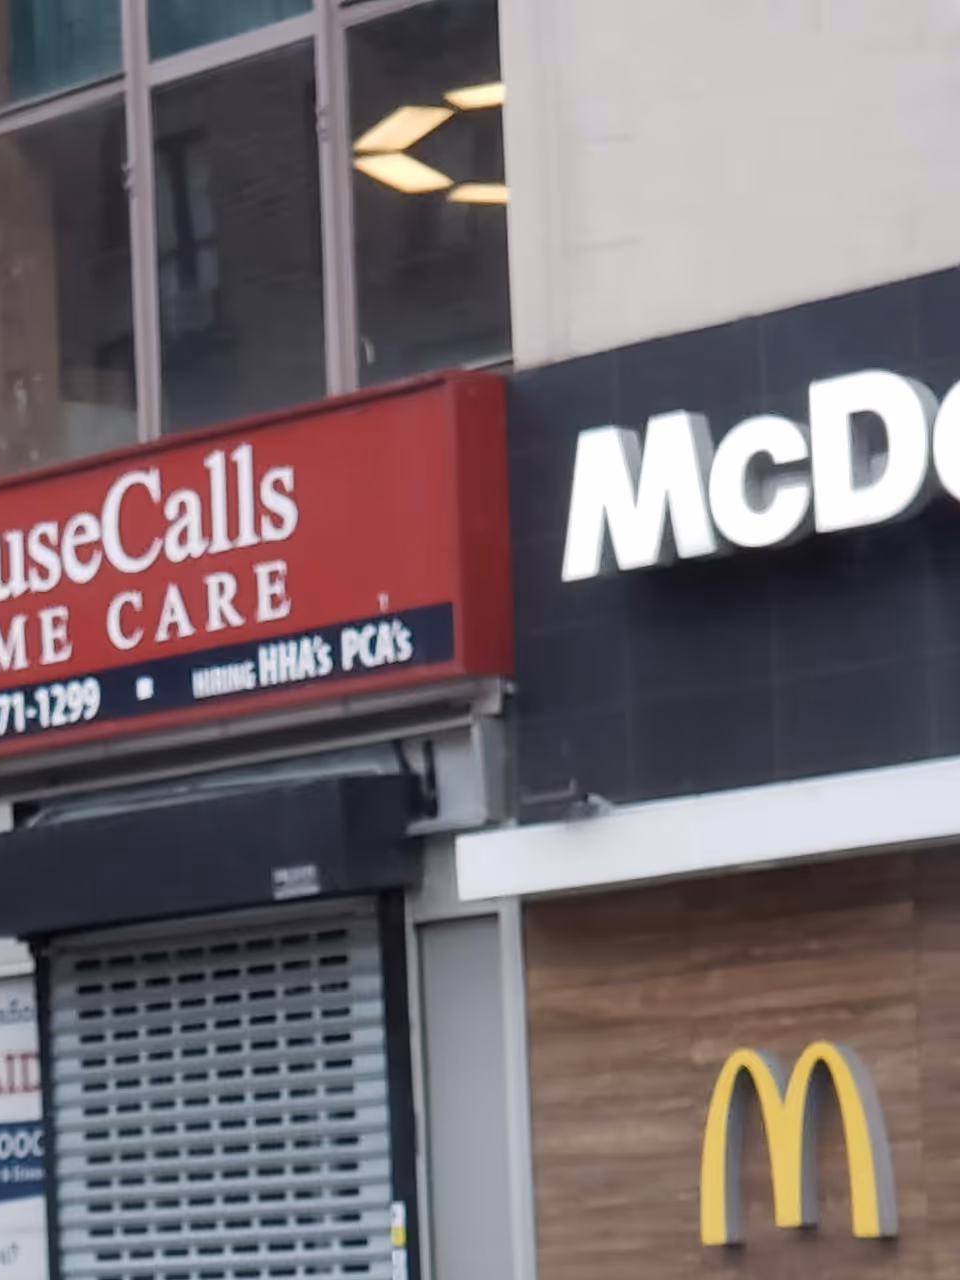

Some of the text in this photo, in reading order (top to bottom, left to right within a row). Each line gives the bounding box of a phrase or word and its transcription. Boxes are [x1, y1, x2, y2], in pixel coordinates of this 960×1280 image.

[561, 367, 960, 583] McD
[106, 559, 292, 651] CARE
[192, 619, 414, 699] HIRING HHA's PCA's
